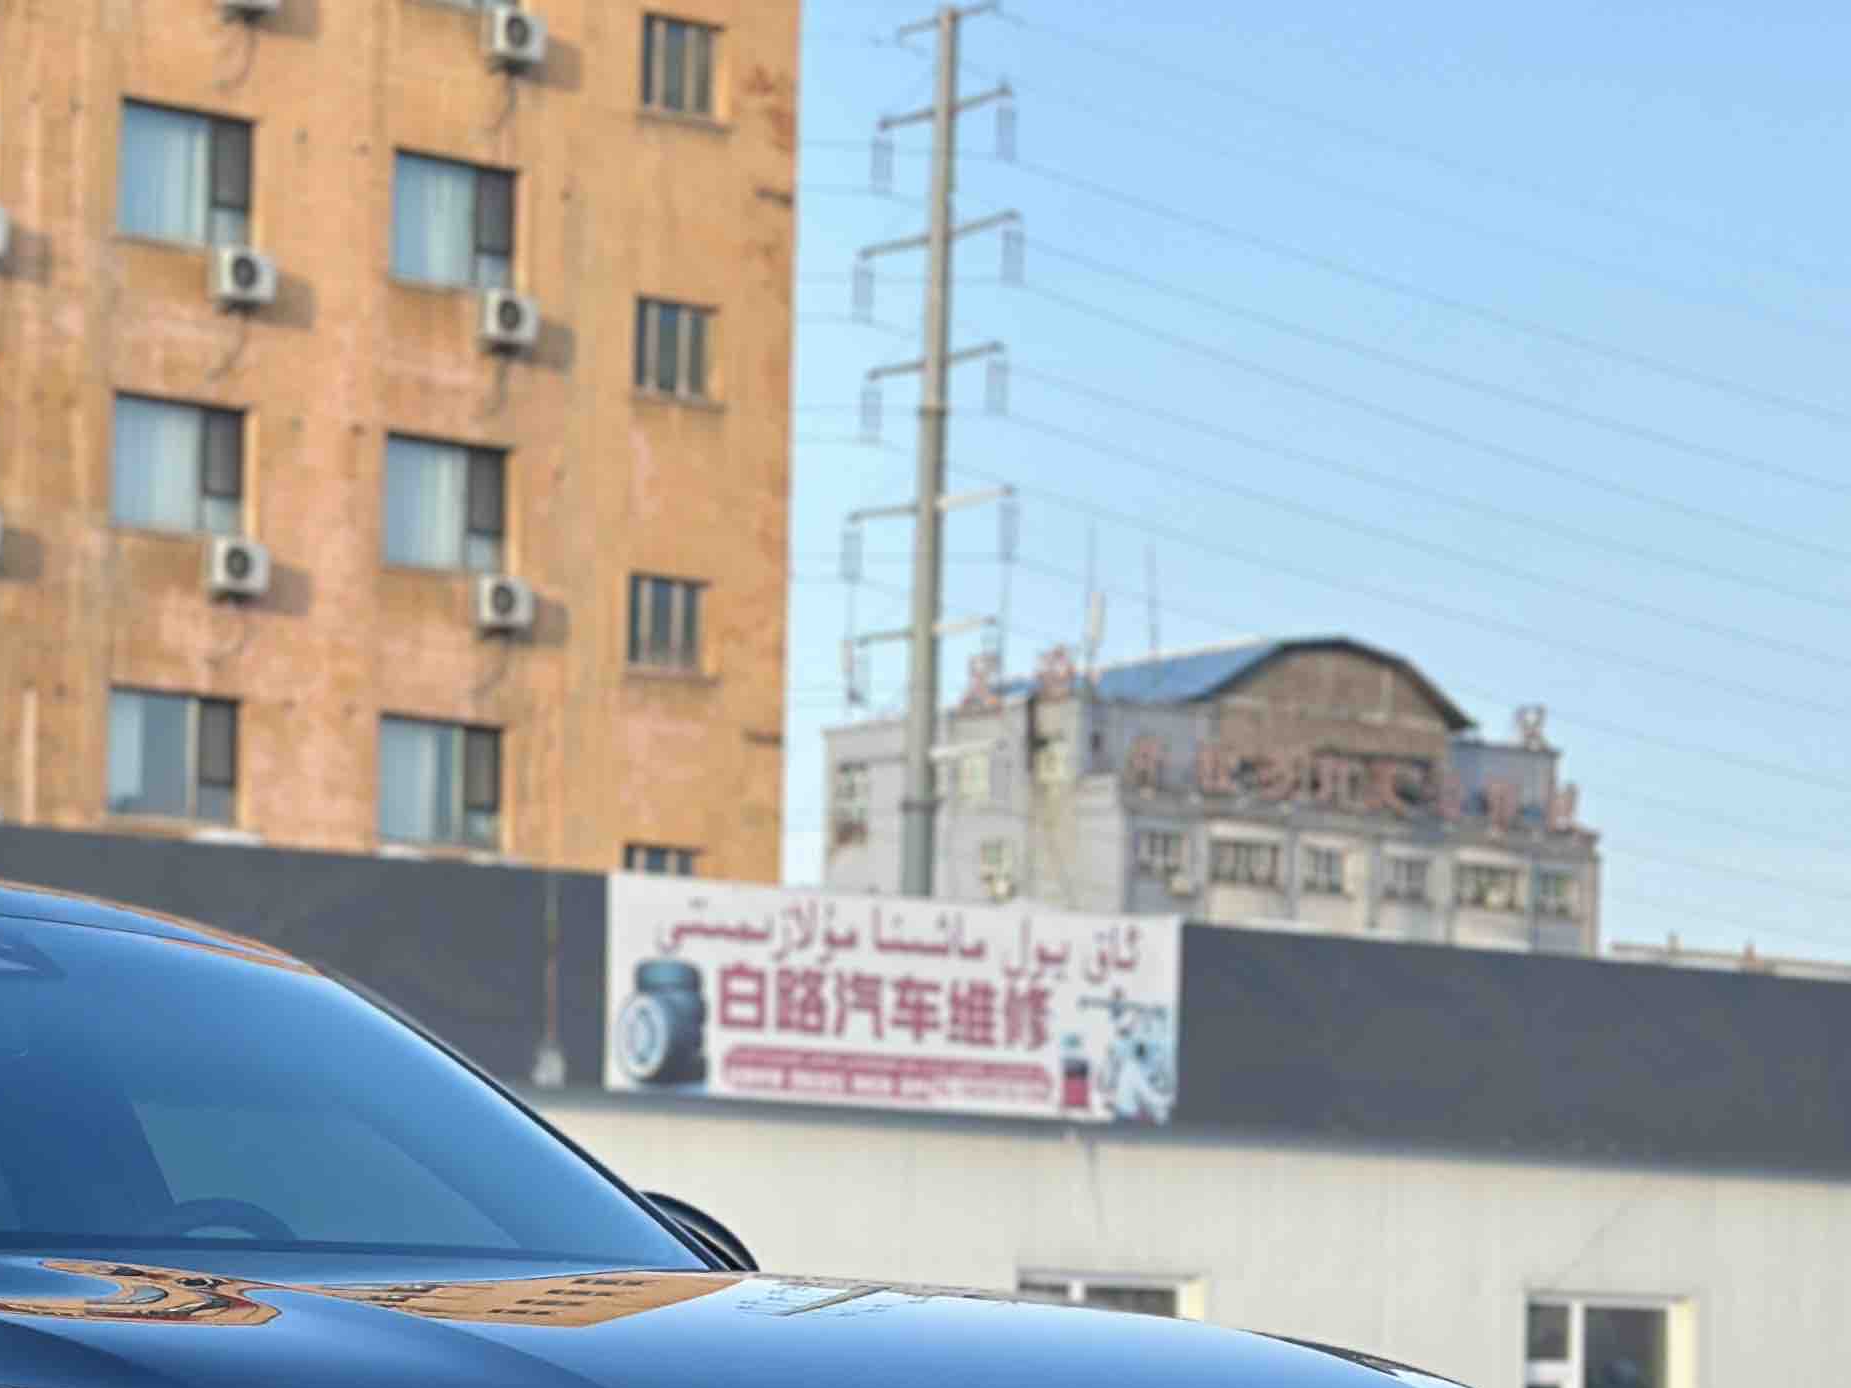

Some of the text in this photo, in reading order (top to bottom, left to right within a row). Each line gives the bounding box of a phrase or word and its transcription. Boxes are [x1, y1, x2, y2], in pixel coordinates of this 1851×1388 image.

[717, 961, 1053, 1050] 白路汽车维修
